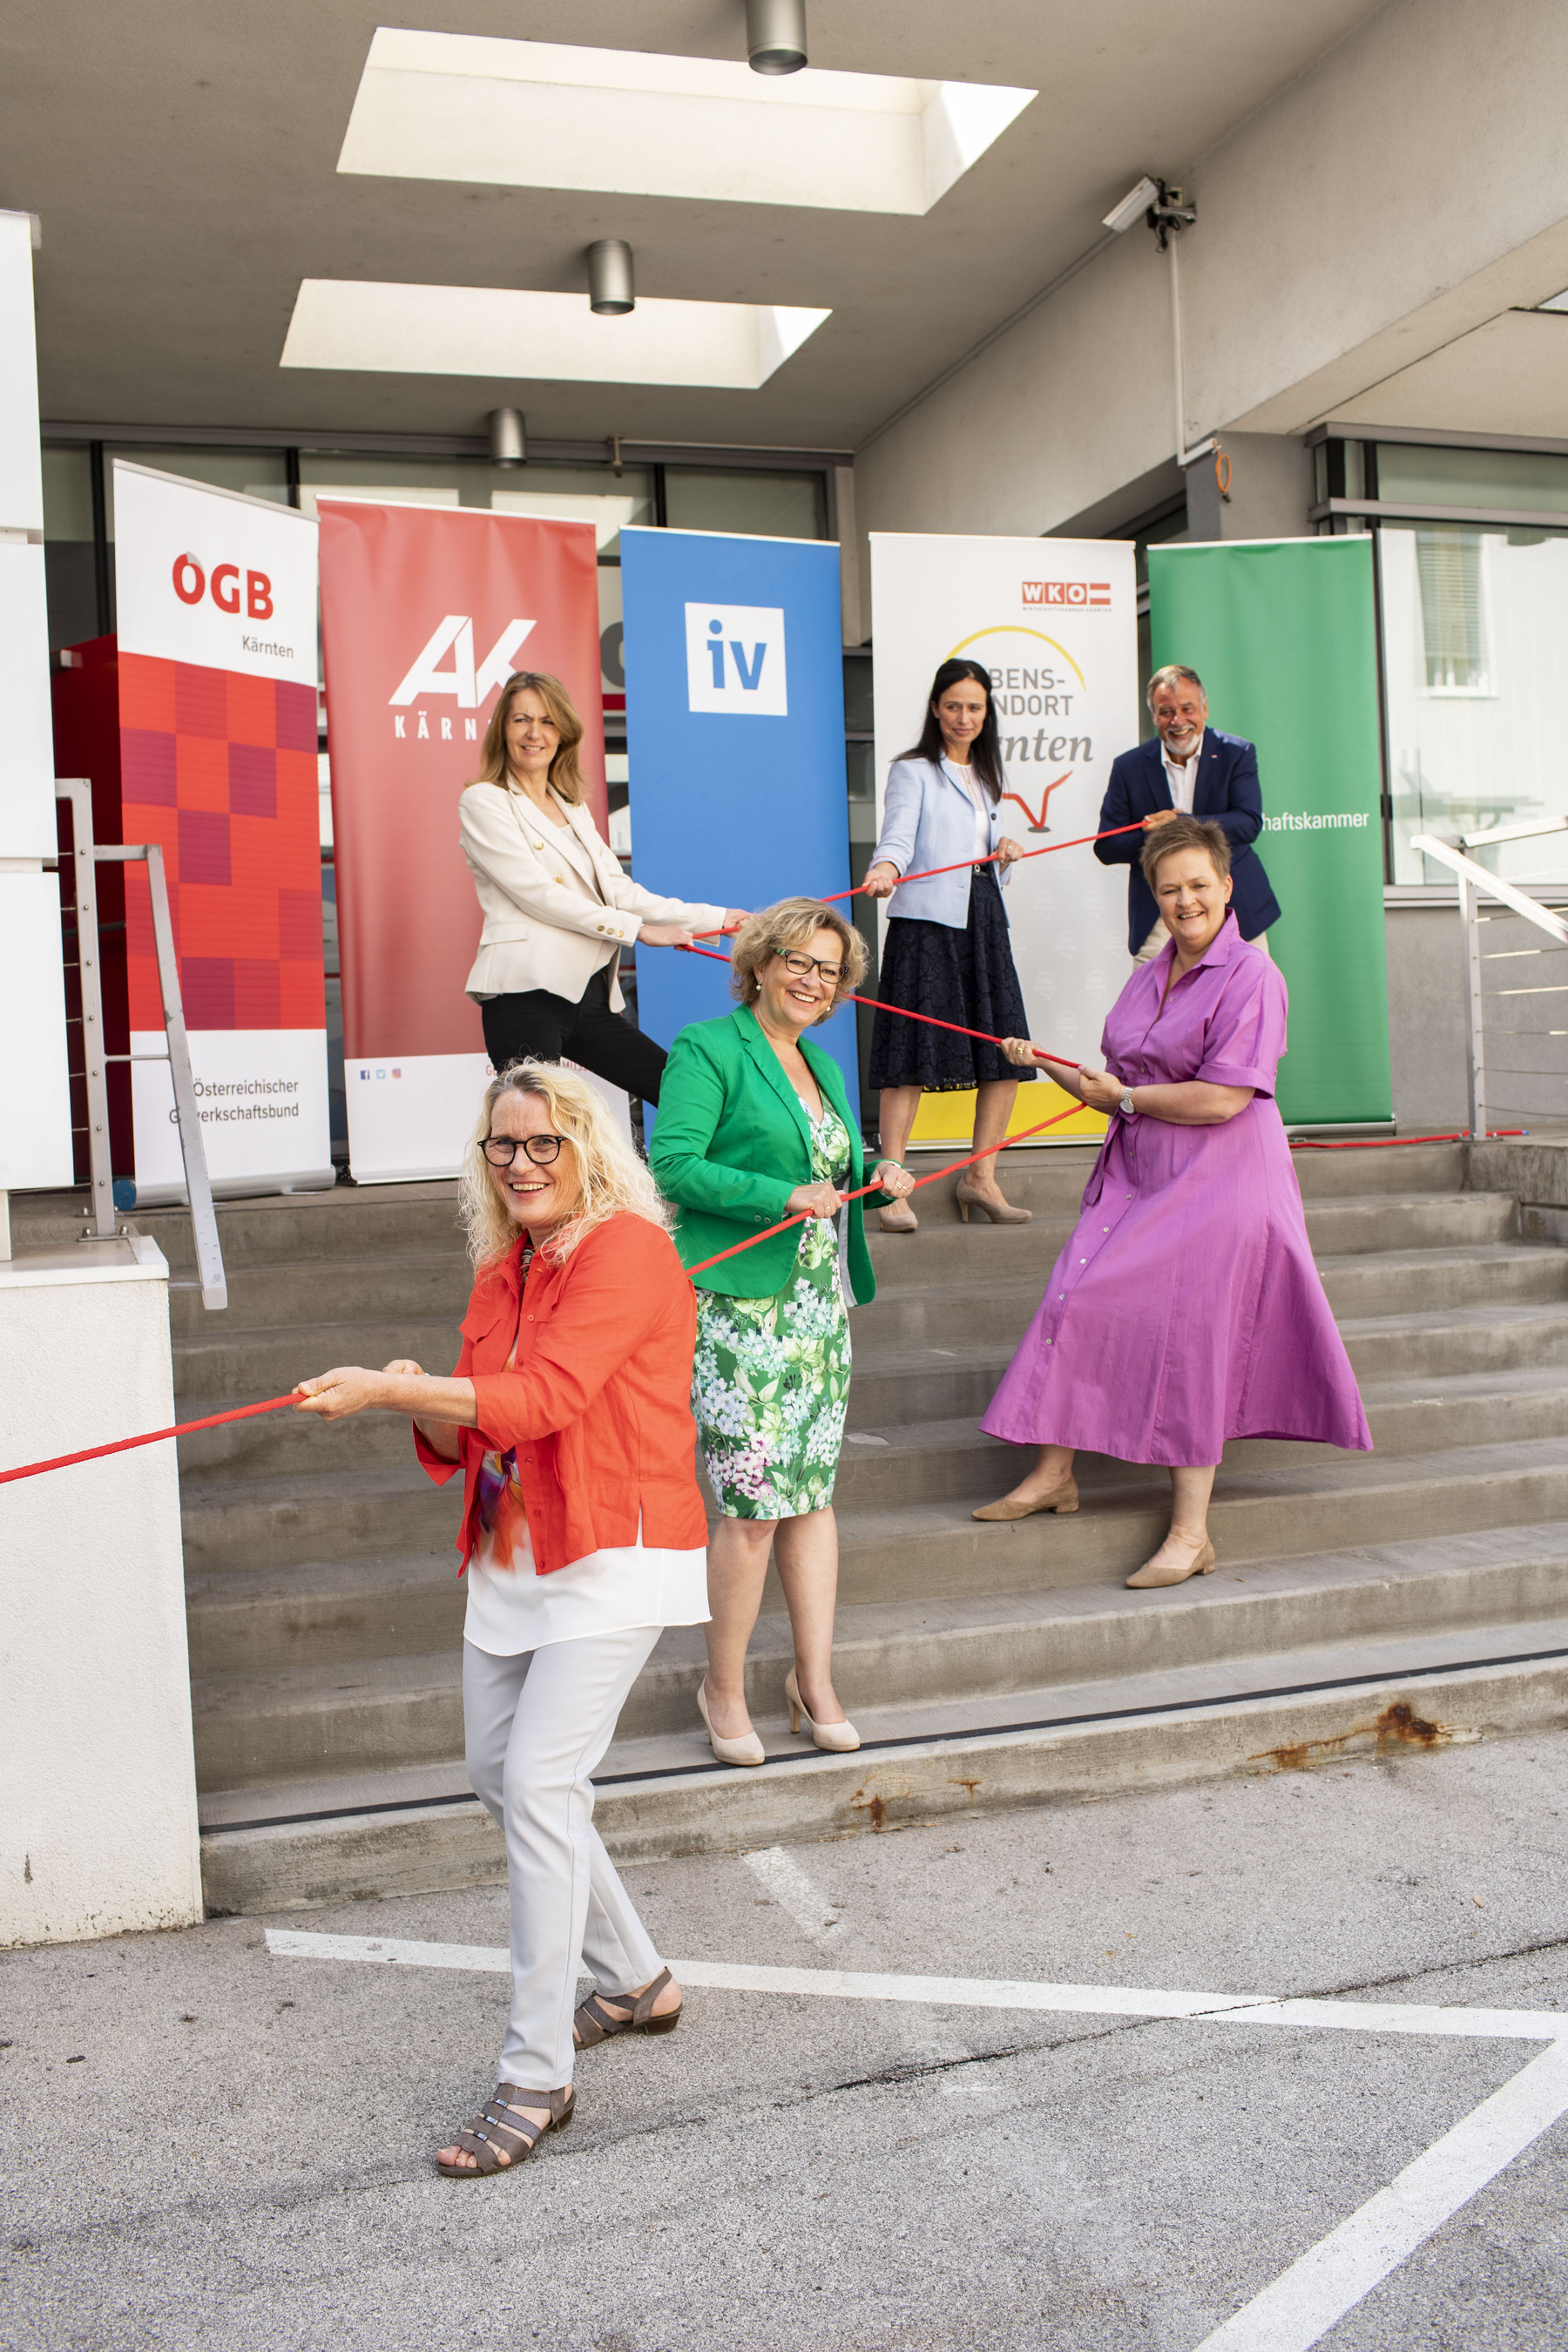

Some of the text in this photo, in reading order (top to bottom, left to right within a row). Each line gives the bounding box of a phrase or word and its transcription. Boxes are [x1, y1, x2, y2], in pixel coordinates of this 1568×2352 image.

[1023, 584, 1085, 603] WKO
[242, 635, 294, 659] Kärnten
[706, 618, 767, 691] iv
[388, 615, 537, 708] AK
[989, 668, 1065, 689] BENS-
[992, 694, 1073, 716] NDORT
[395, 711, 492, 740] KÄRN
[1262, 811, 1370, 831] haftskammer
[193, 1078, 299, 1097] Österreichischer
[169, 1102, 300, 1124] Gerkschaftsbund
